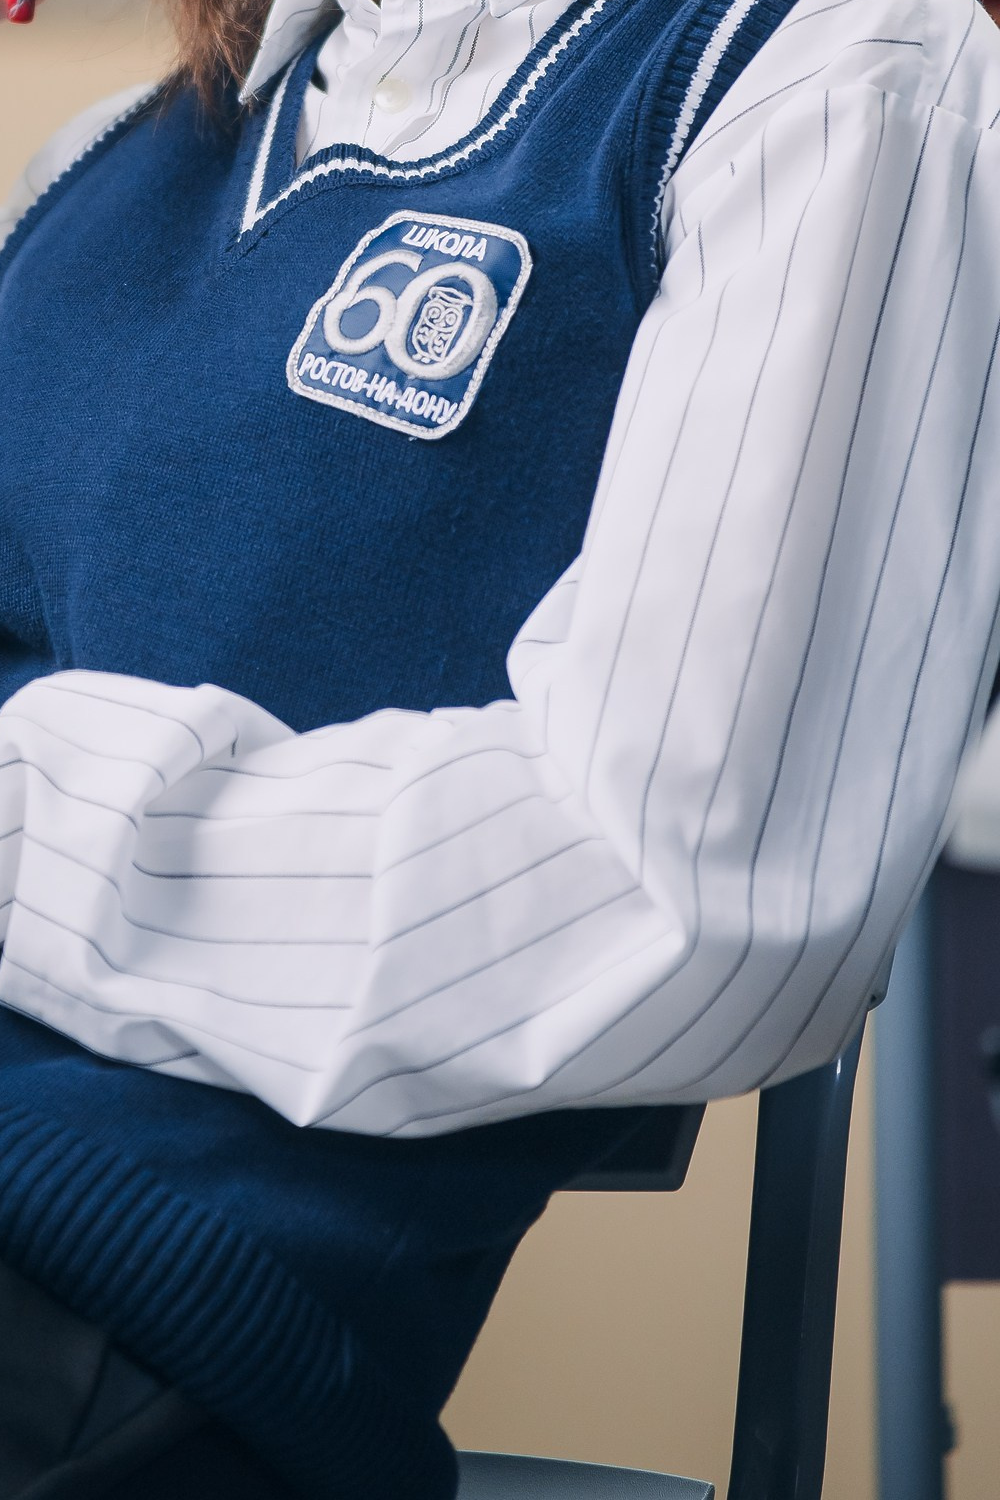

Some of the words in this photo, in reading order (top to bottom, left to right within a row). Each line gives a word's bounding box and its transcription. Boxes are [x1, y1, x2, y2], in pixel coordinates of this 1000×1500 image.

[402, 225, 488, 261] ШКОЛА
[323, 249, 498, 381] 60
[299, 353, 456, 424] РОСТОВ-НА-ДОНУ
